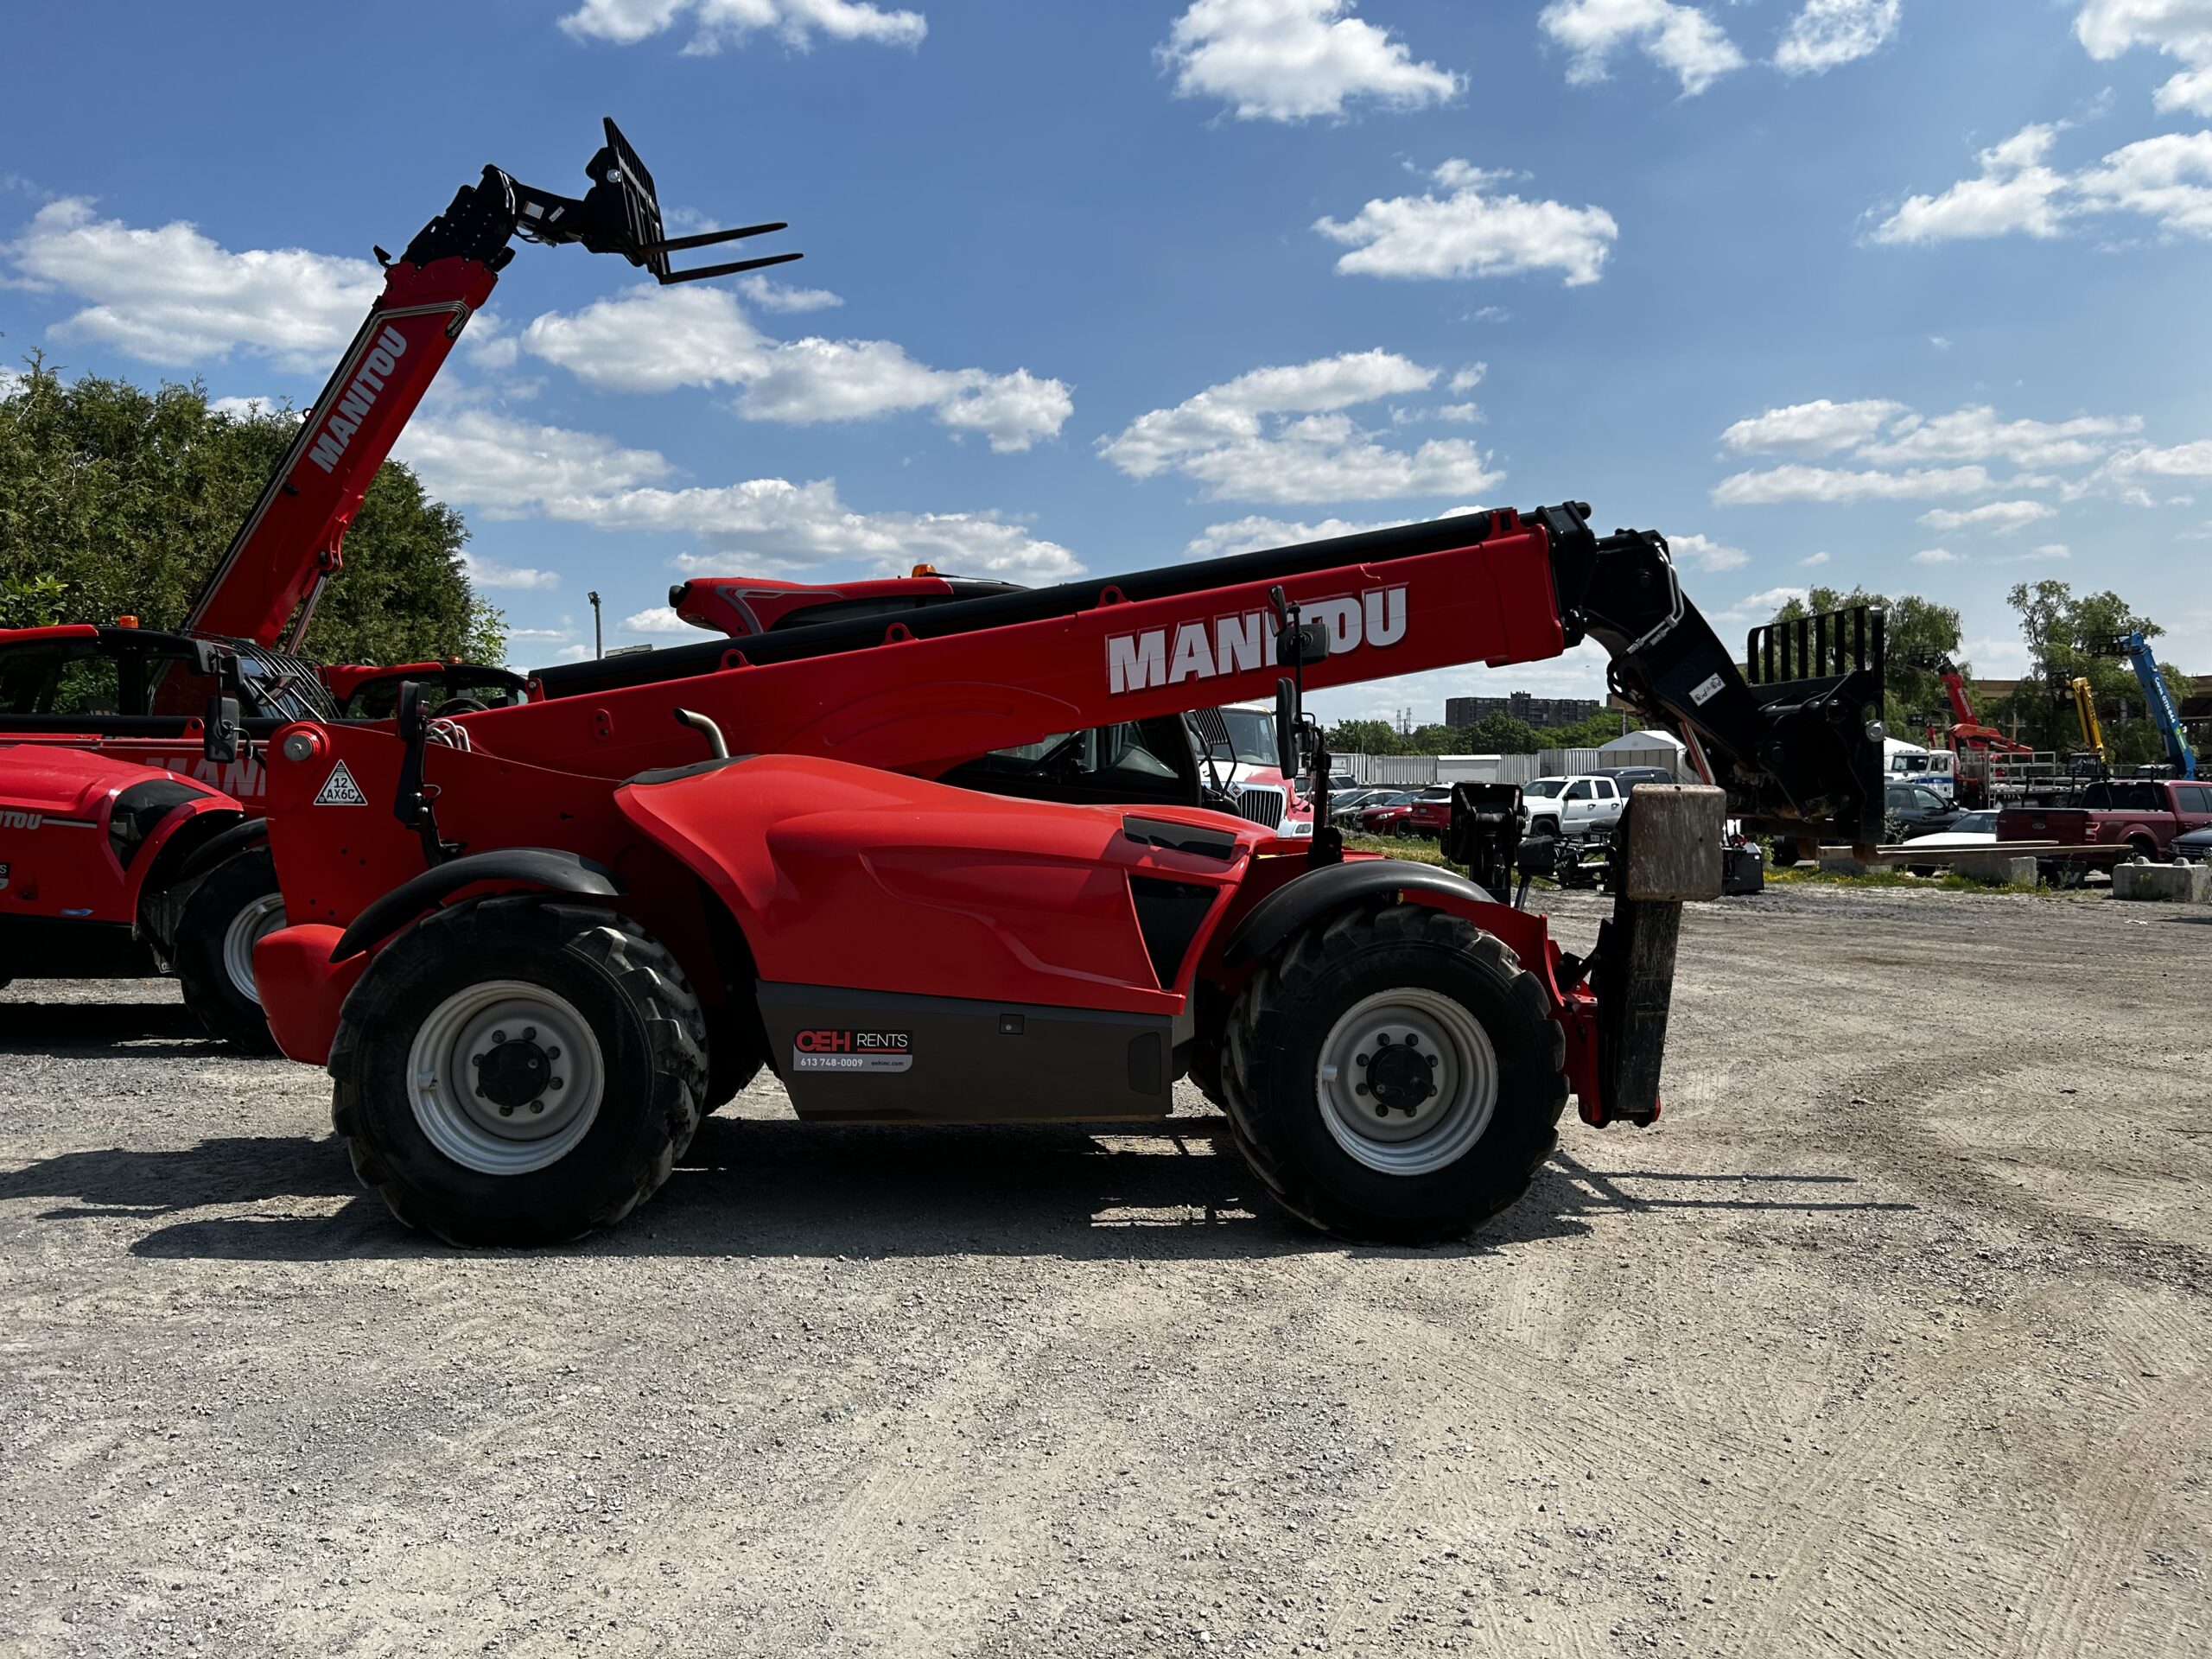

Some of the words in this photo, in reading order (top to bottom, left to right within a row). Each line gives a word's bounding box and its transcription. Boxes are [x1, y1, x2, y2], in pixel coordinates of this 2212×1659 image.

[308, 326, 407, 474] MANITOU
[334, 778, 348, 788] 12
[327, 789, 355, 799] AX6C
[796, 1030, 850, 1052] OEH
[856, 1033, 908, 1047] RENTS
[800, 1058, 817, 1066] 613
[820, 1058, 863, 1067] 748-0009
